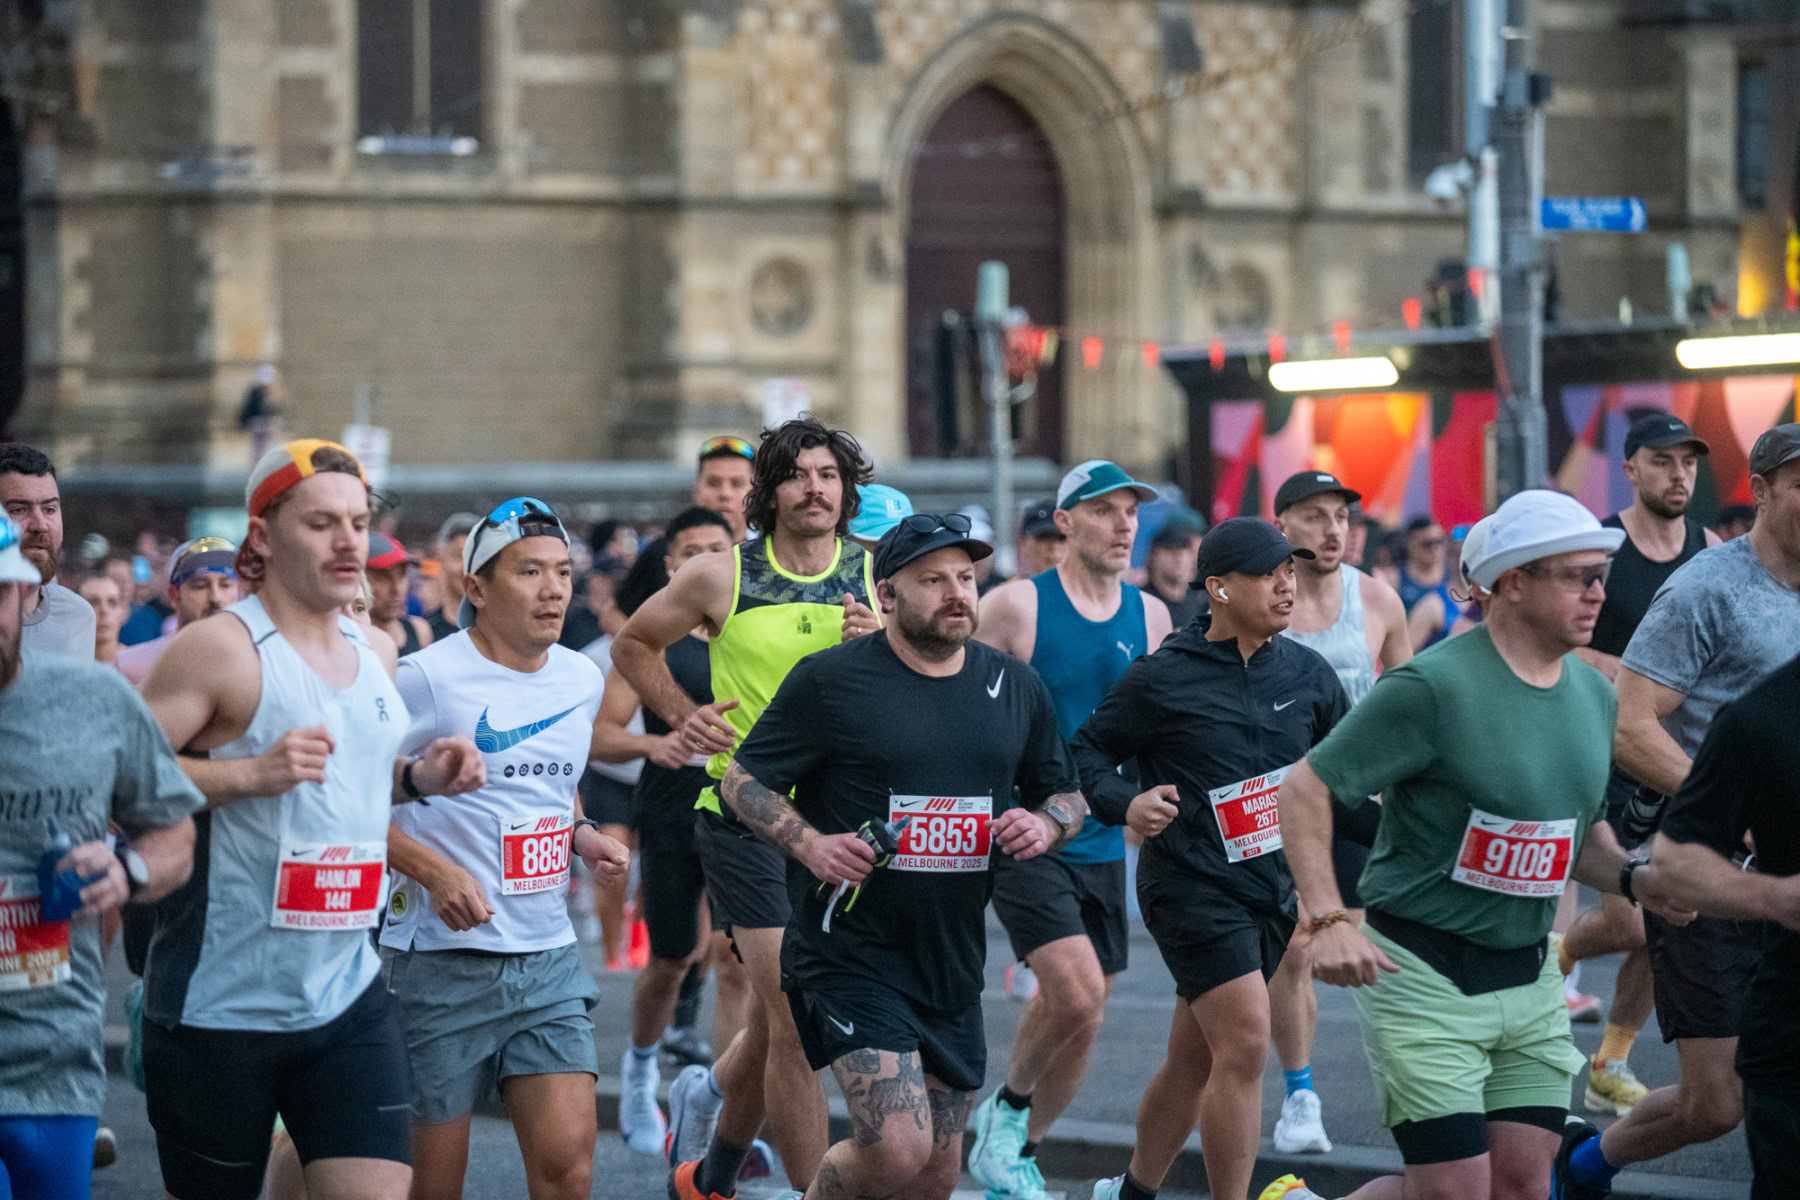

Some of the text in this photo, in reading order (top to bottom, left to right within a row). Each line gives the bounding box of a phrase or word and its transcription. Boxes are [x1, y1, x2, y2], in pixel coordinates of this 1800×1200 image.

[1255, 808, 1279, 829] 2677
[910, 816, 978, 854] 5853
[522, 831, 569, 875] 8850
[898, 857, 982, 869] MELBOURNE 2025
[1483, 838, 1557, 879] 9108
[314, 869, 362, 889] HANLON
[513, 876, 560, 892] MELBOURNE
[1465, 872, 1530, 893] MELBOURNE
[324, 890, 352, 910] 1441
[285, 913, 349, 926] MELBOURNE
